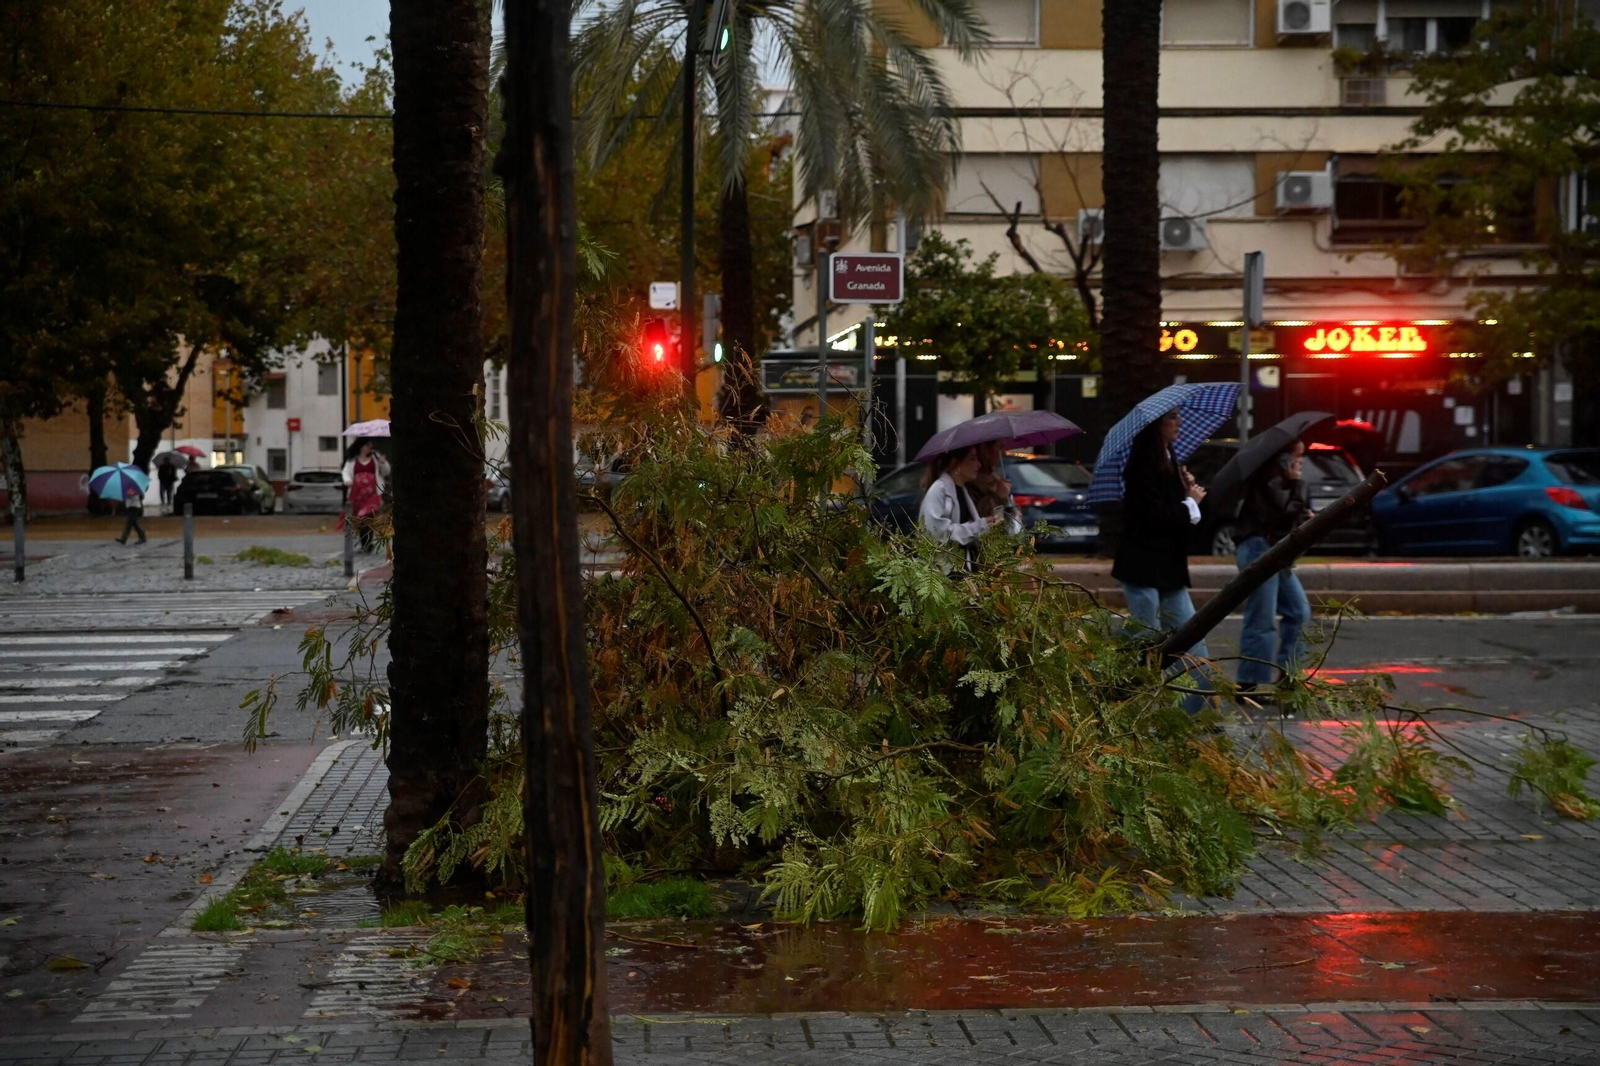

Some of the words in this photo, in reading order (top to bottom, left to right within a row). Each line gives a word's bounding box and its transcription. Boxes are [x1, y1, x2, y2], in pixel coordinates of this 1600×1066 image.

[855, 263, 892, 273] Avenida
[846, 280, 886, 291] Granada
[1303, 327, 1428, 352] JOKER
